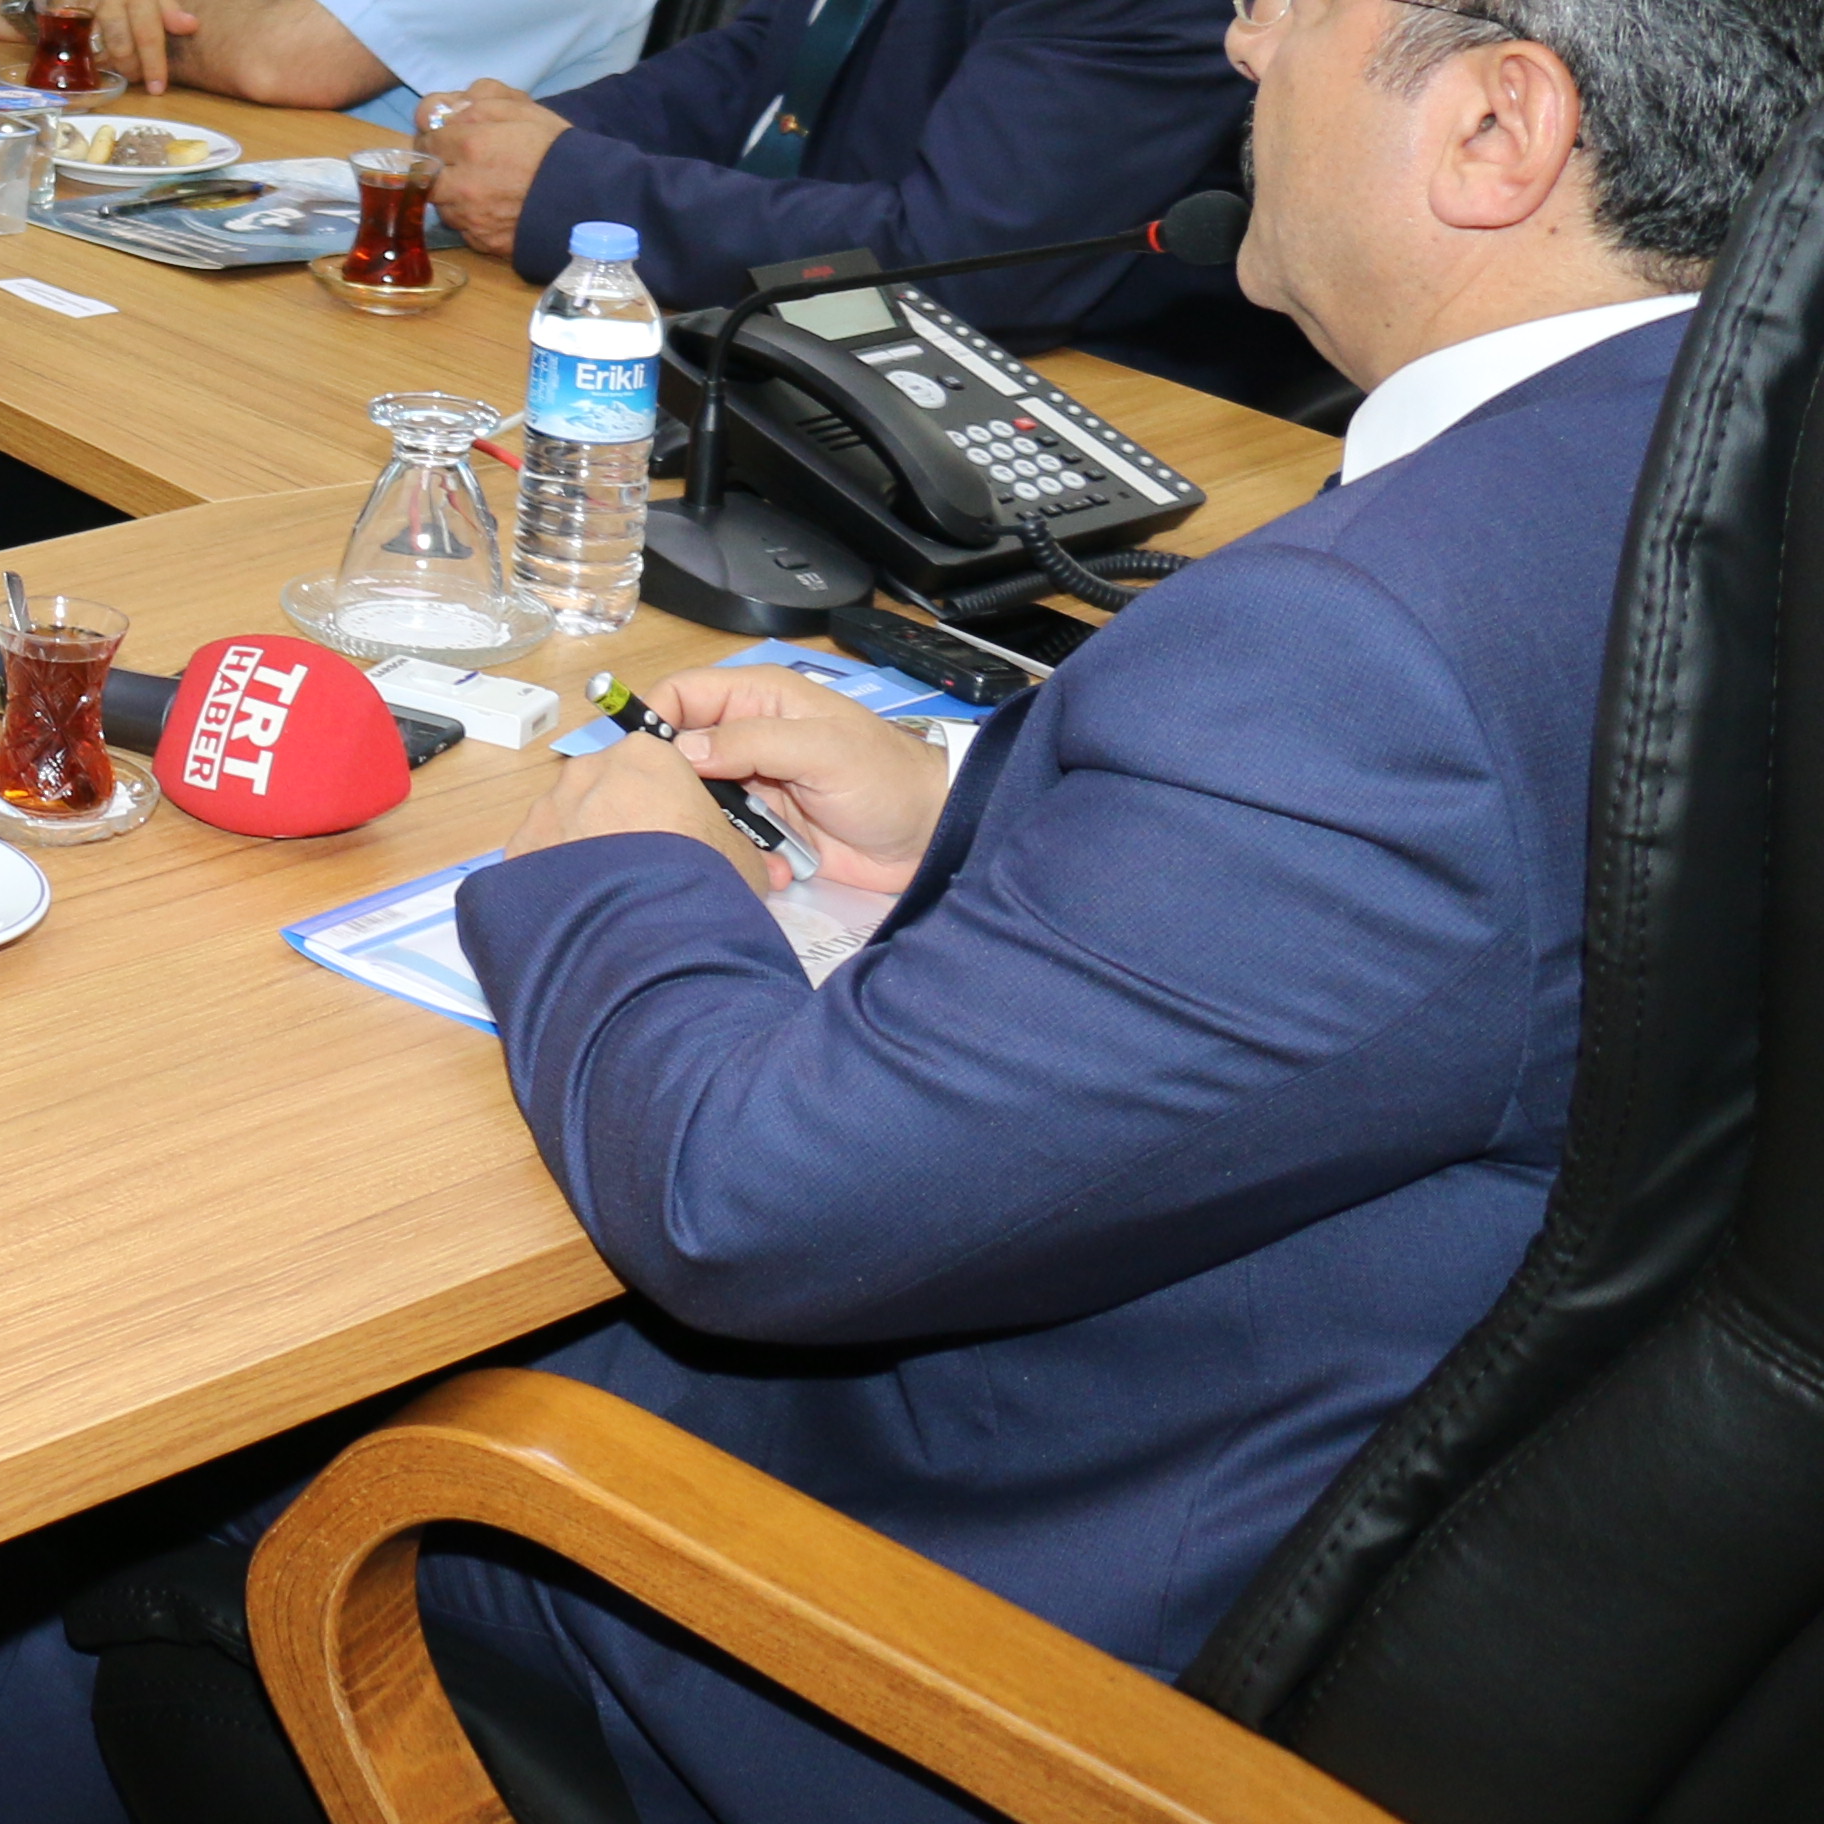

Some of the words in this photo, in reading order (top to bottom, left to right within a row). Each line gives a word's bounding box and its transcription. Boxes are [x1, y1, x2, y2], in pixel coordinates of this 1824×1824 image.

[575, 362, 646, 391] Erikli
[189, 650, 255, 782] HABER
[222, 663, 309, 796] TRT
